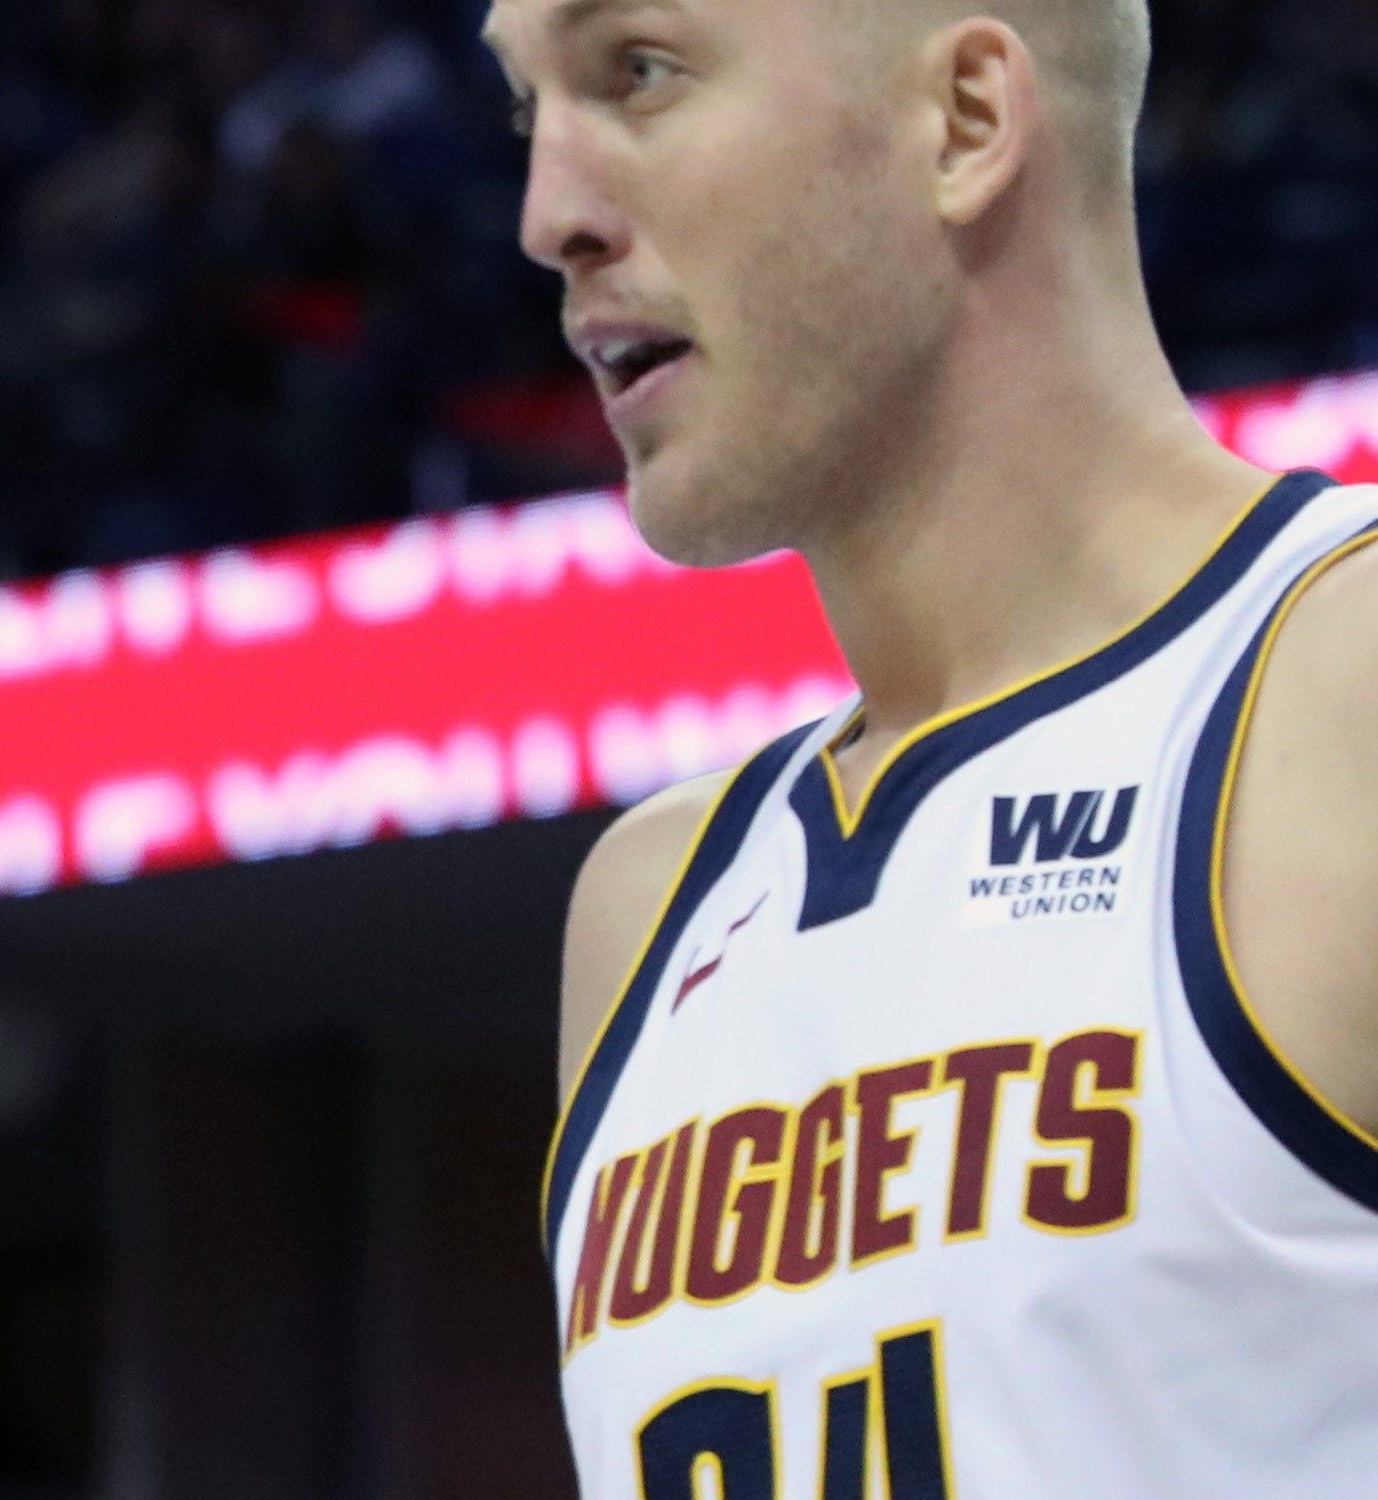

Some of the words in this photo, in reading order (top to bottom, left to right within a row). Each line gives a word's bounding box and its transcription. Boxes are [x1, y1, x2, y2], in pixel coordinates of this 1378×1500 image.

[989, 783, 1141, 866] WU
[969, 865, 1121, 898] WESTERN
[1011, 891, 1117, 919] UNION
[559, 1025, 1146, 1362] NUGGETS
